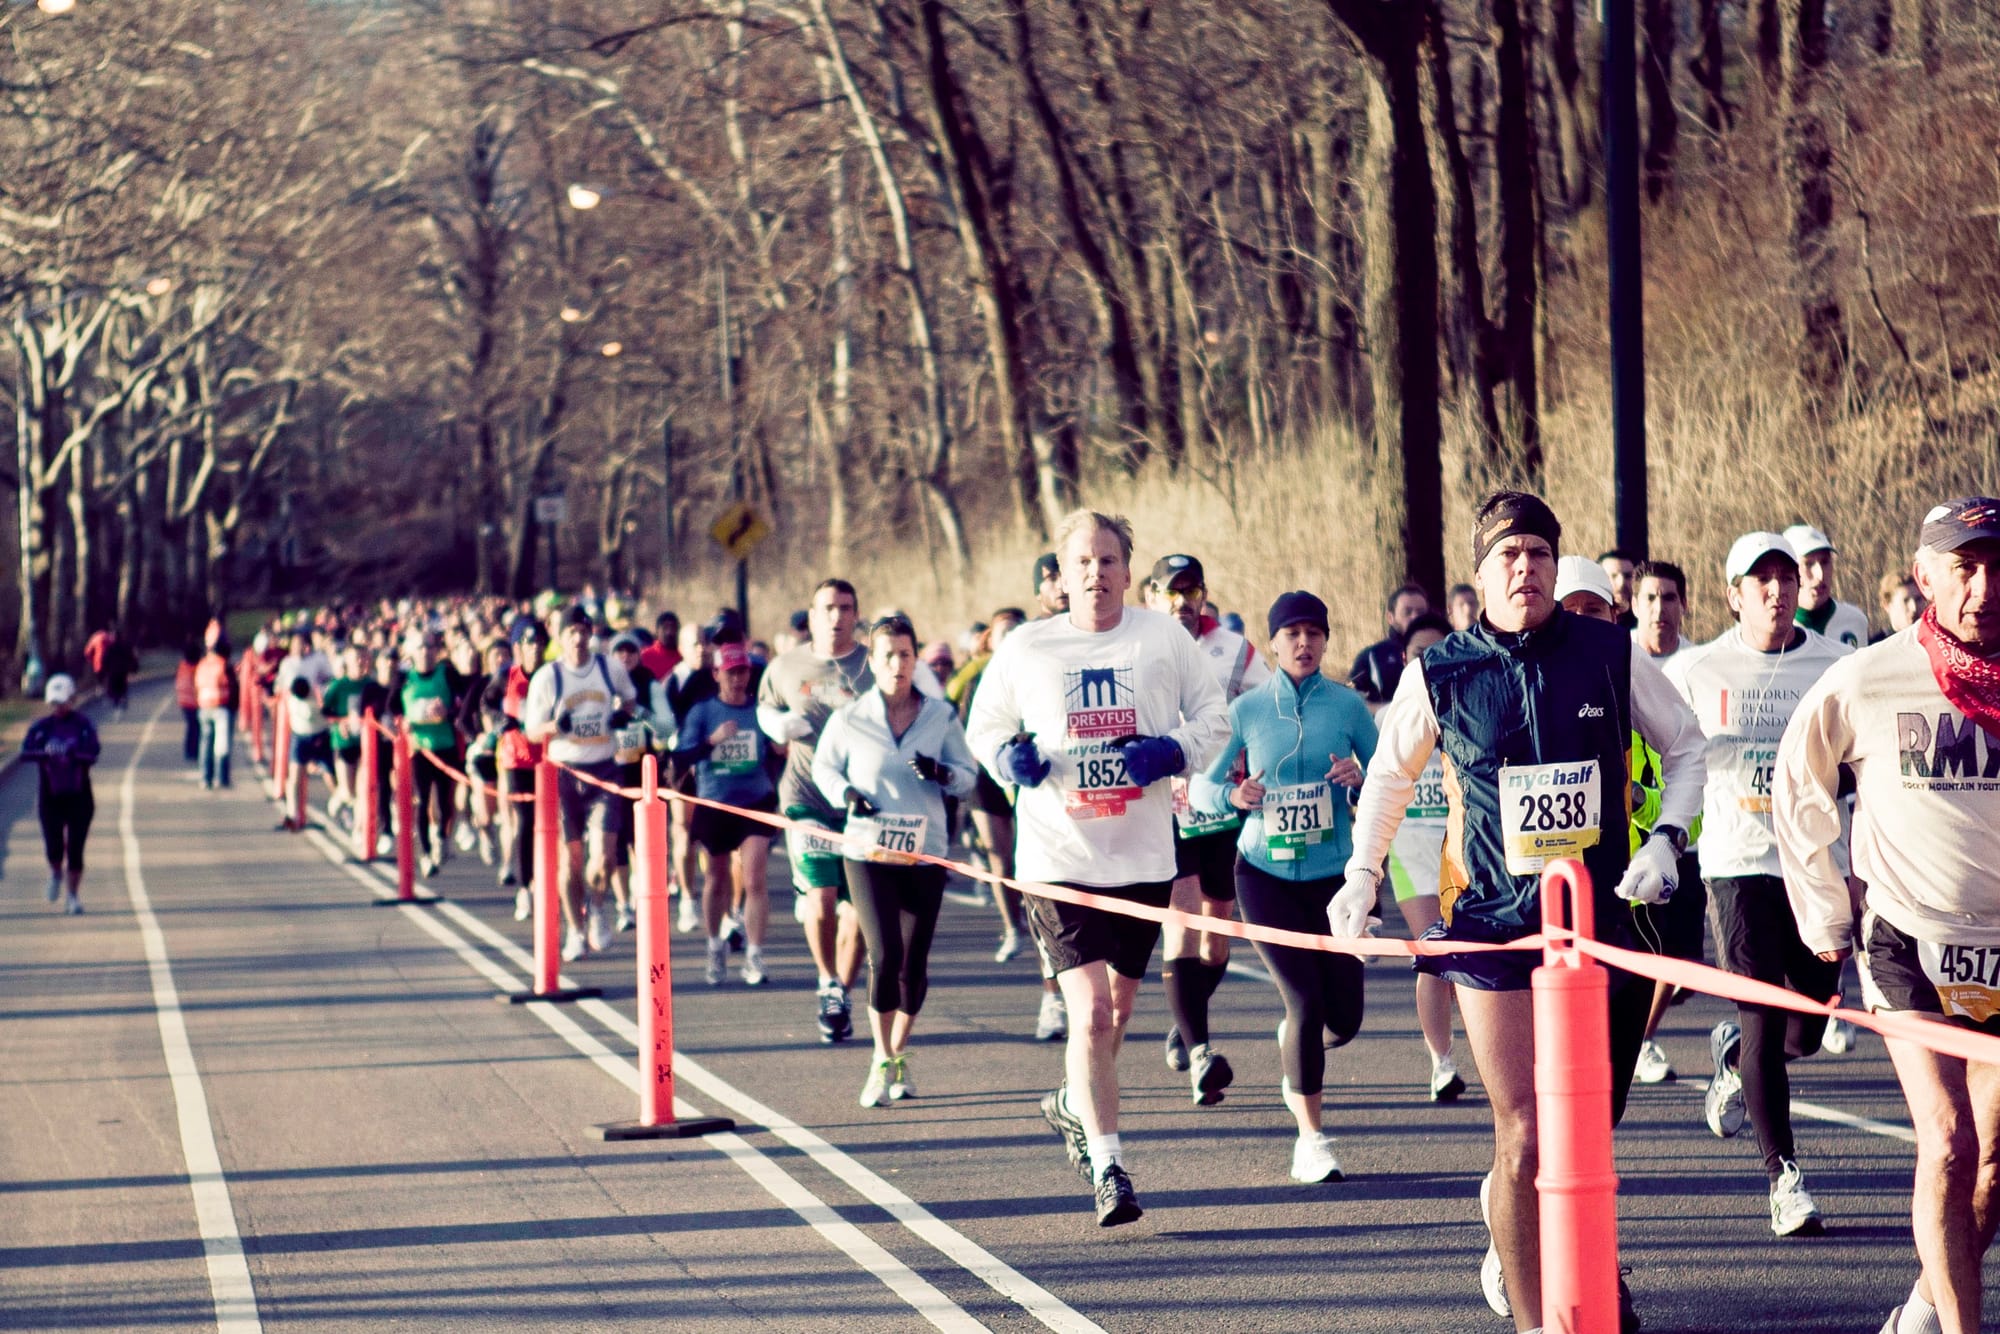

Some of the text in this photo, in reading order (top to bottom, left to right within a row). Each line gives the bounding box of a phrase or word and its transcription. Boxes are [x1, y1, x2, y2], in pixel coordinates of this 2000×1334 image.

[1731, 688, 1800, 701] CHILDREN
[1577, 702, 1605, 718] asics
[1741, 703, 1774, 713] PERU
[1068, 709, 1136, 727] DREYFUS
[574, 720, 601, 737] 4252
[1093, 730, 1112, 738] FOR
[1115, 728, 1135, 737] THE
[720, 743, 750, 761] 3233
[1076, 758, 1128, 789] 1852
[1414, 783, 1448, 806] 335
[1902, 781, 2000, 792] ROCKY MOUNTAIN YOUT
[1276, 803, 1322, 833] 3731
[1519, 790, 1587, 832] 2838
[877, 829, 917, 854] 4776
[1940, 945, 2000, 987] 4517
